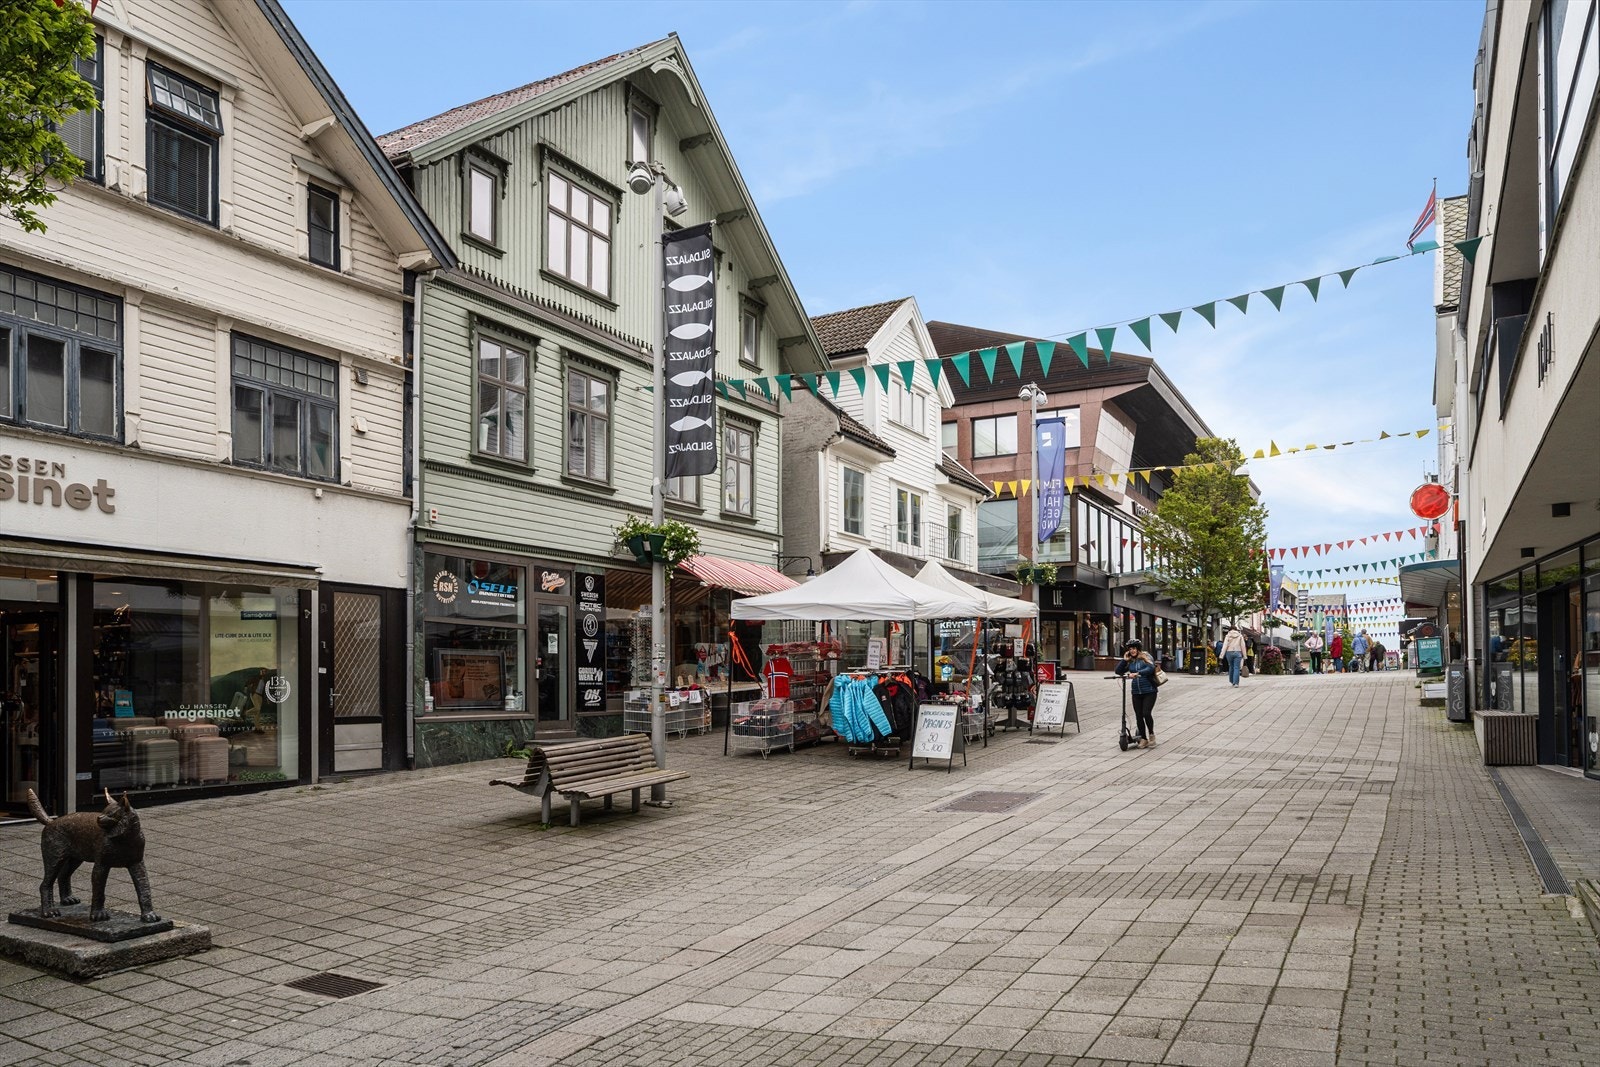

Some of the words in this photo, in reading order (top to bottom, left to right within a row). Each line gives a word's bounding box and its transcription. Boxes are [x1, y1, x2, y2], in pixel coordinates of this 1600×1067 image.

[438, 581, 454, 593] RSN
[480, 582, 516, 594] SELF
[164, 706, 241, 722] magasinet
[922, 717, 953, 730] MAGNTS
